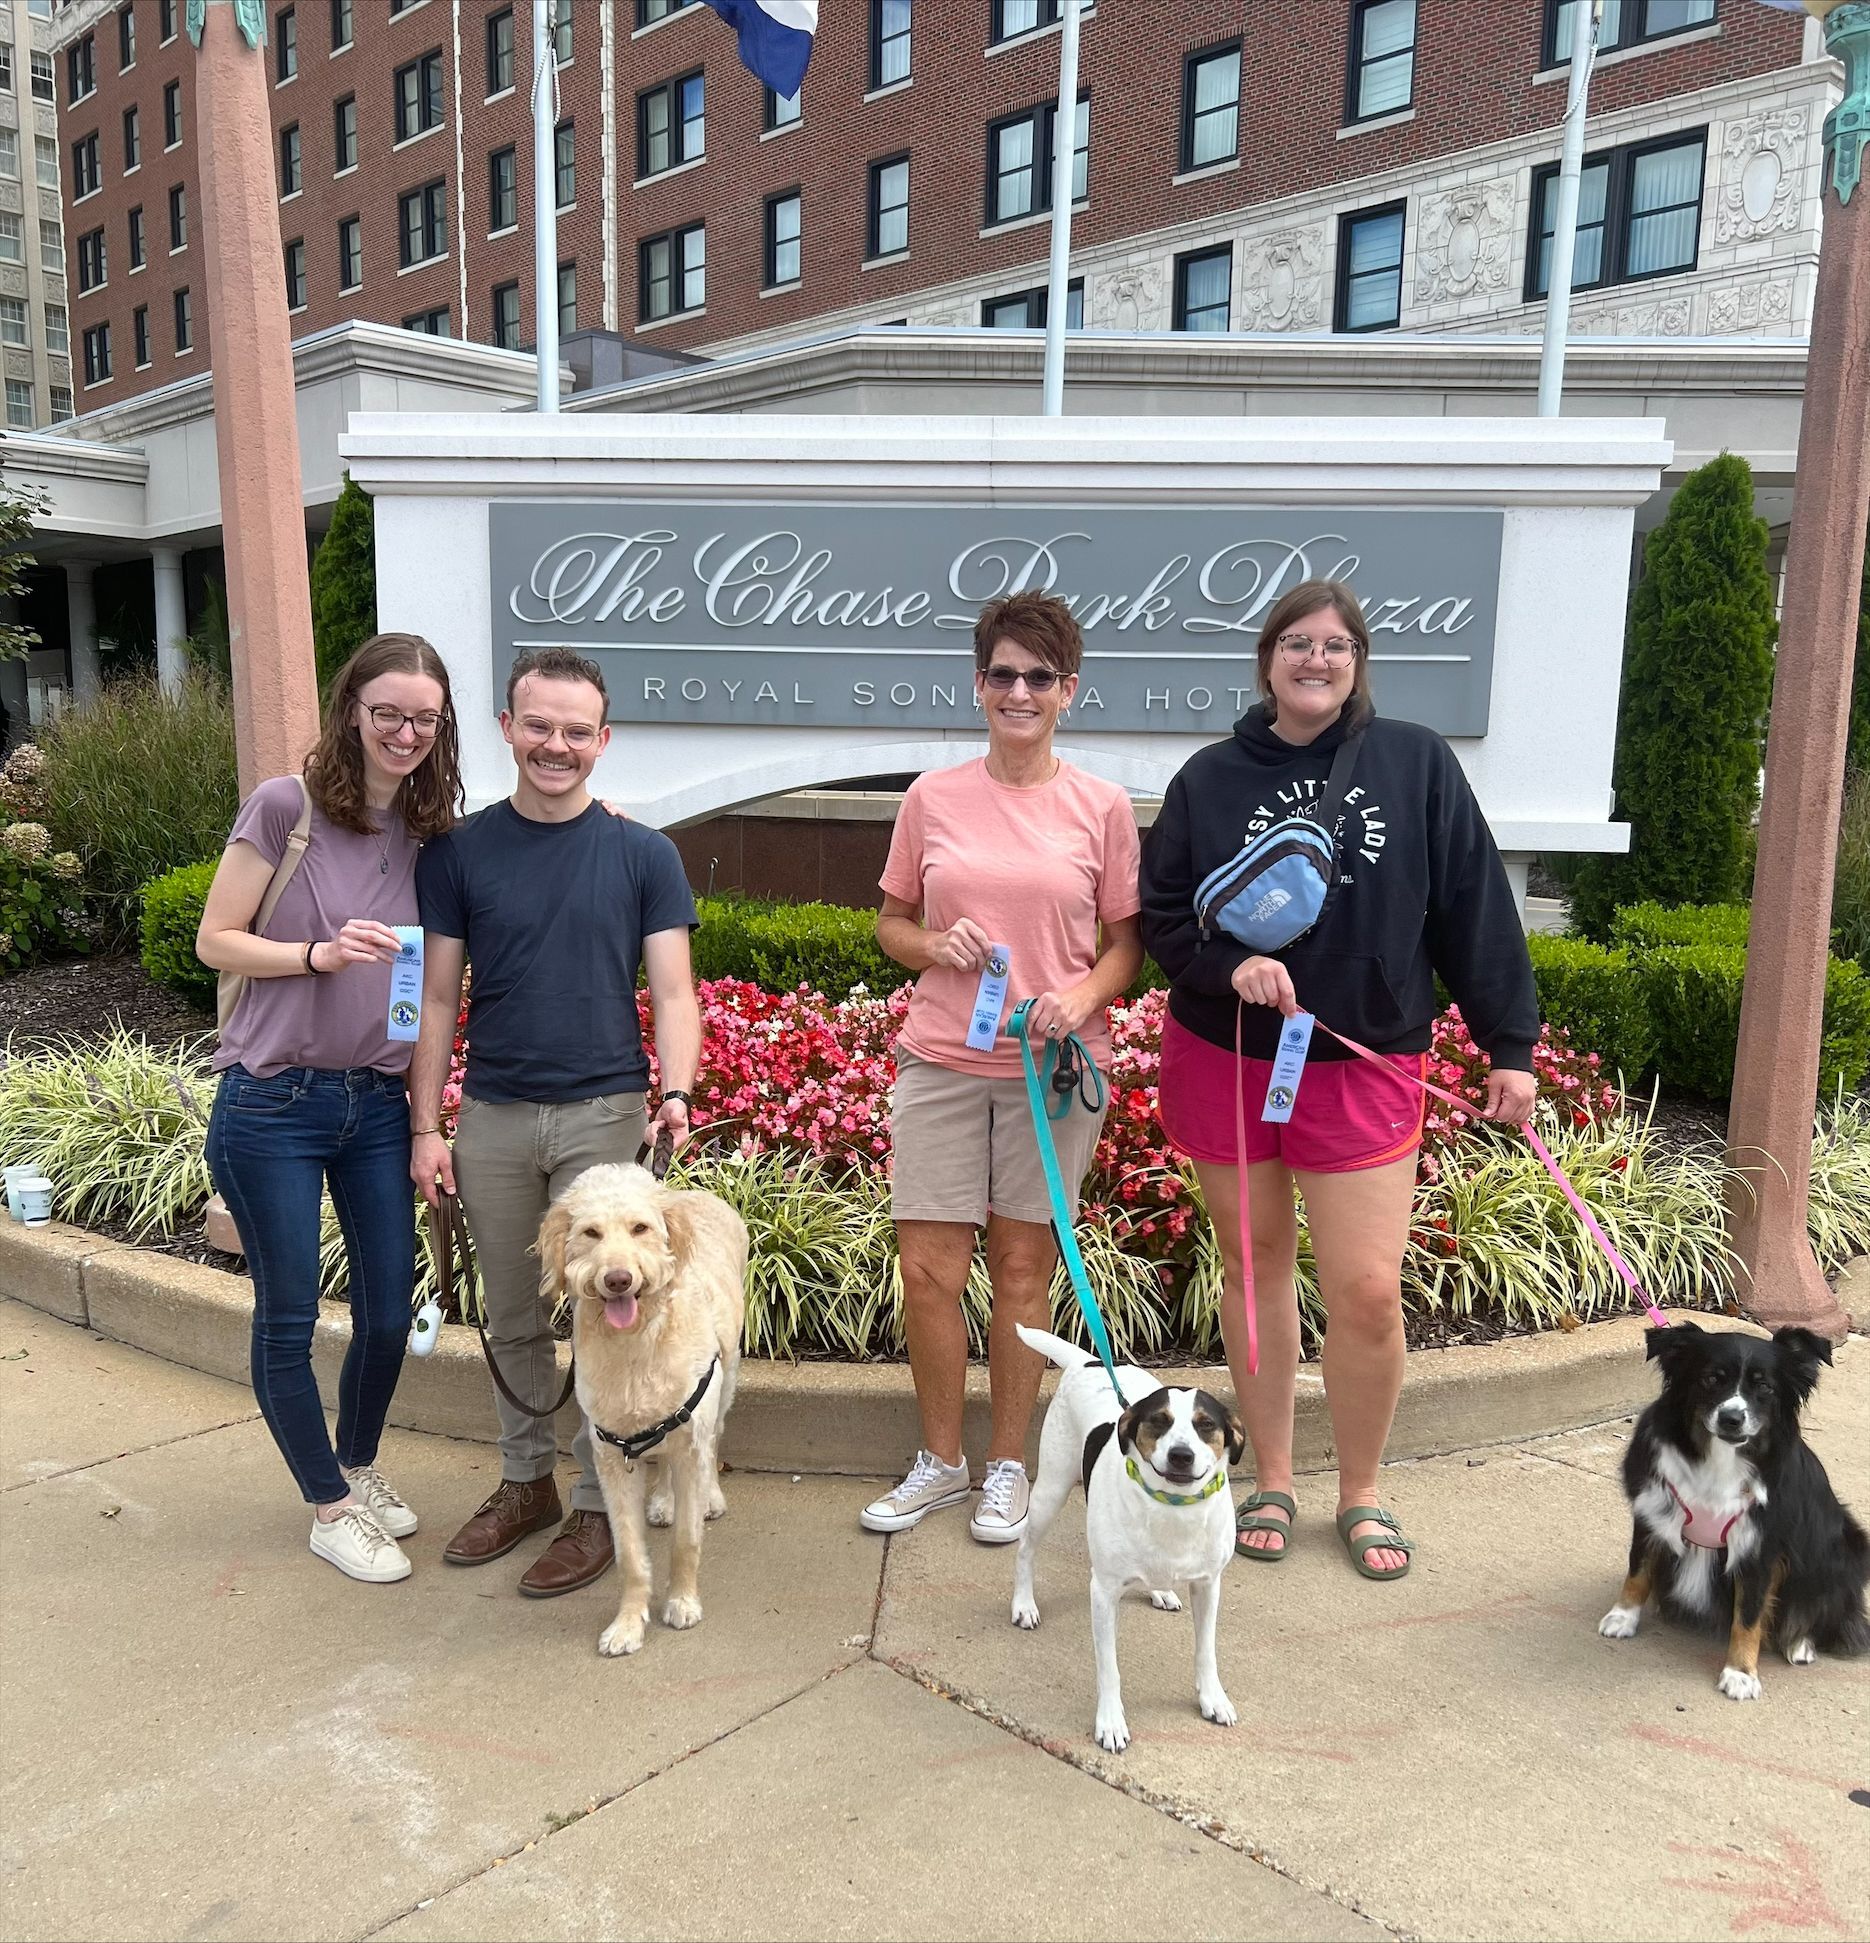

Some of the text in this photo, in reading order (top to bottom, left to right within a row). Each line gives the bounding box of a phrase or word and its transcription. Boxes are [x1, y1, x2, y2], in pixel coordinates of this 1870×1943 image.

[509, 529, 688, 625] The
[692, 531, 933, 629] Chase
[642, 677, 815, 705] ROYAL
[1359, 805, 1386, 865] LADY
